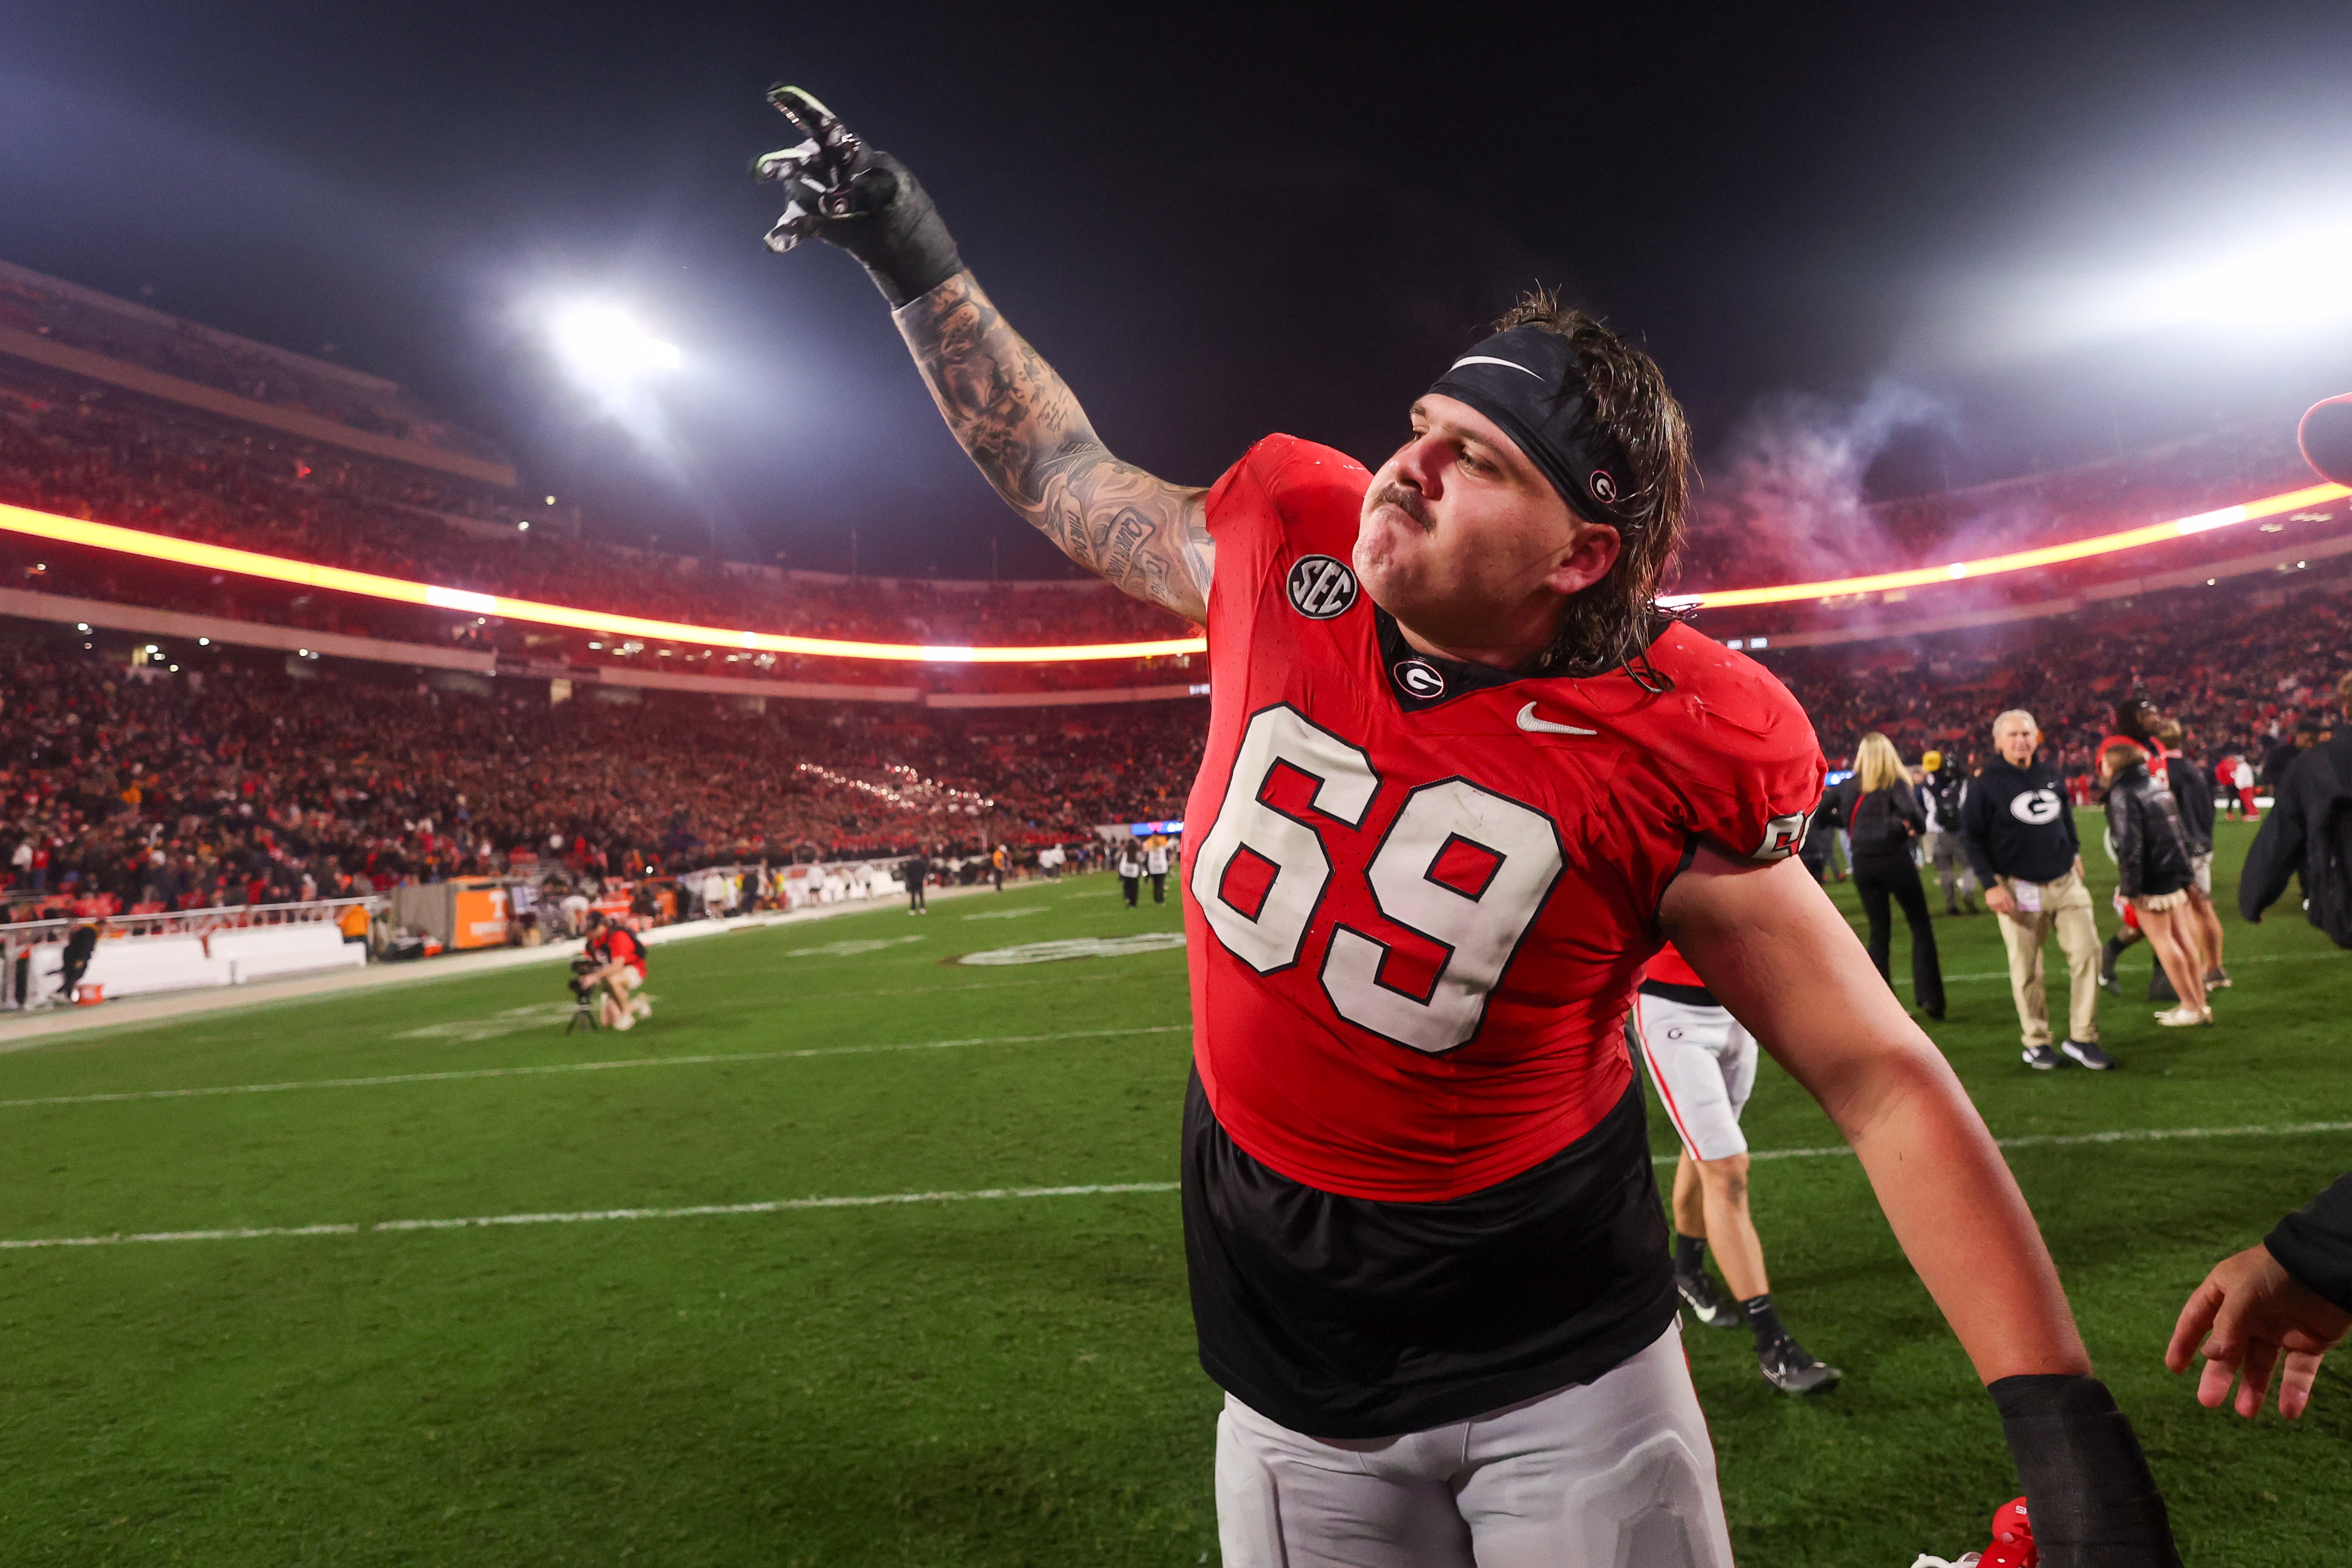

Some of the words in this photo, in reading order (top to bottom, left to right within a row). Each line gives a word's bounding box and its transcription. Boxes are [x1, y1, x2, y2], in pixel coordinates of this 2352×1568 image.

[1293, 560, 1351, 614] SEC
[2010, 788, 2061, 825] G
[1191, 701, 1568, 1056] 69
